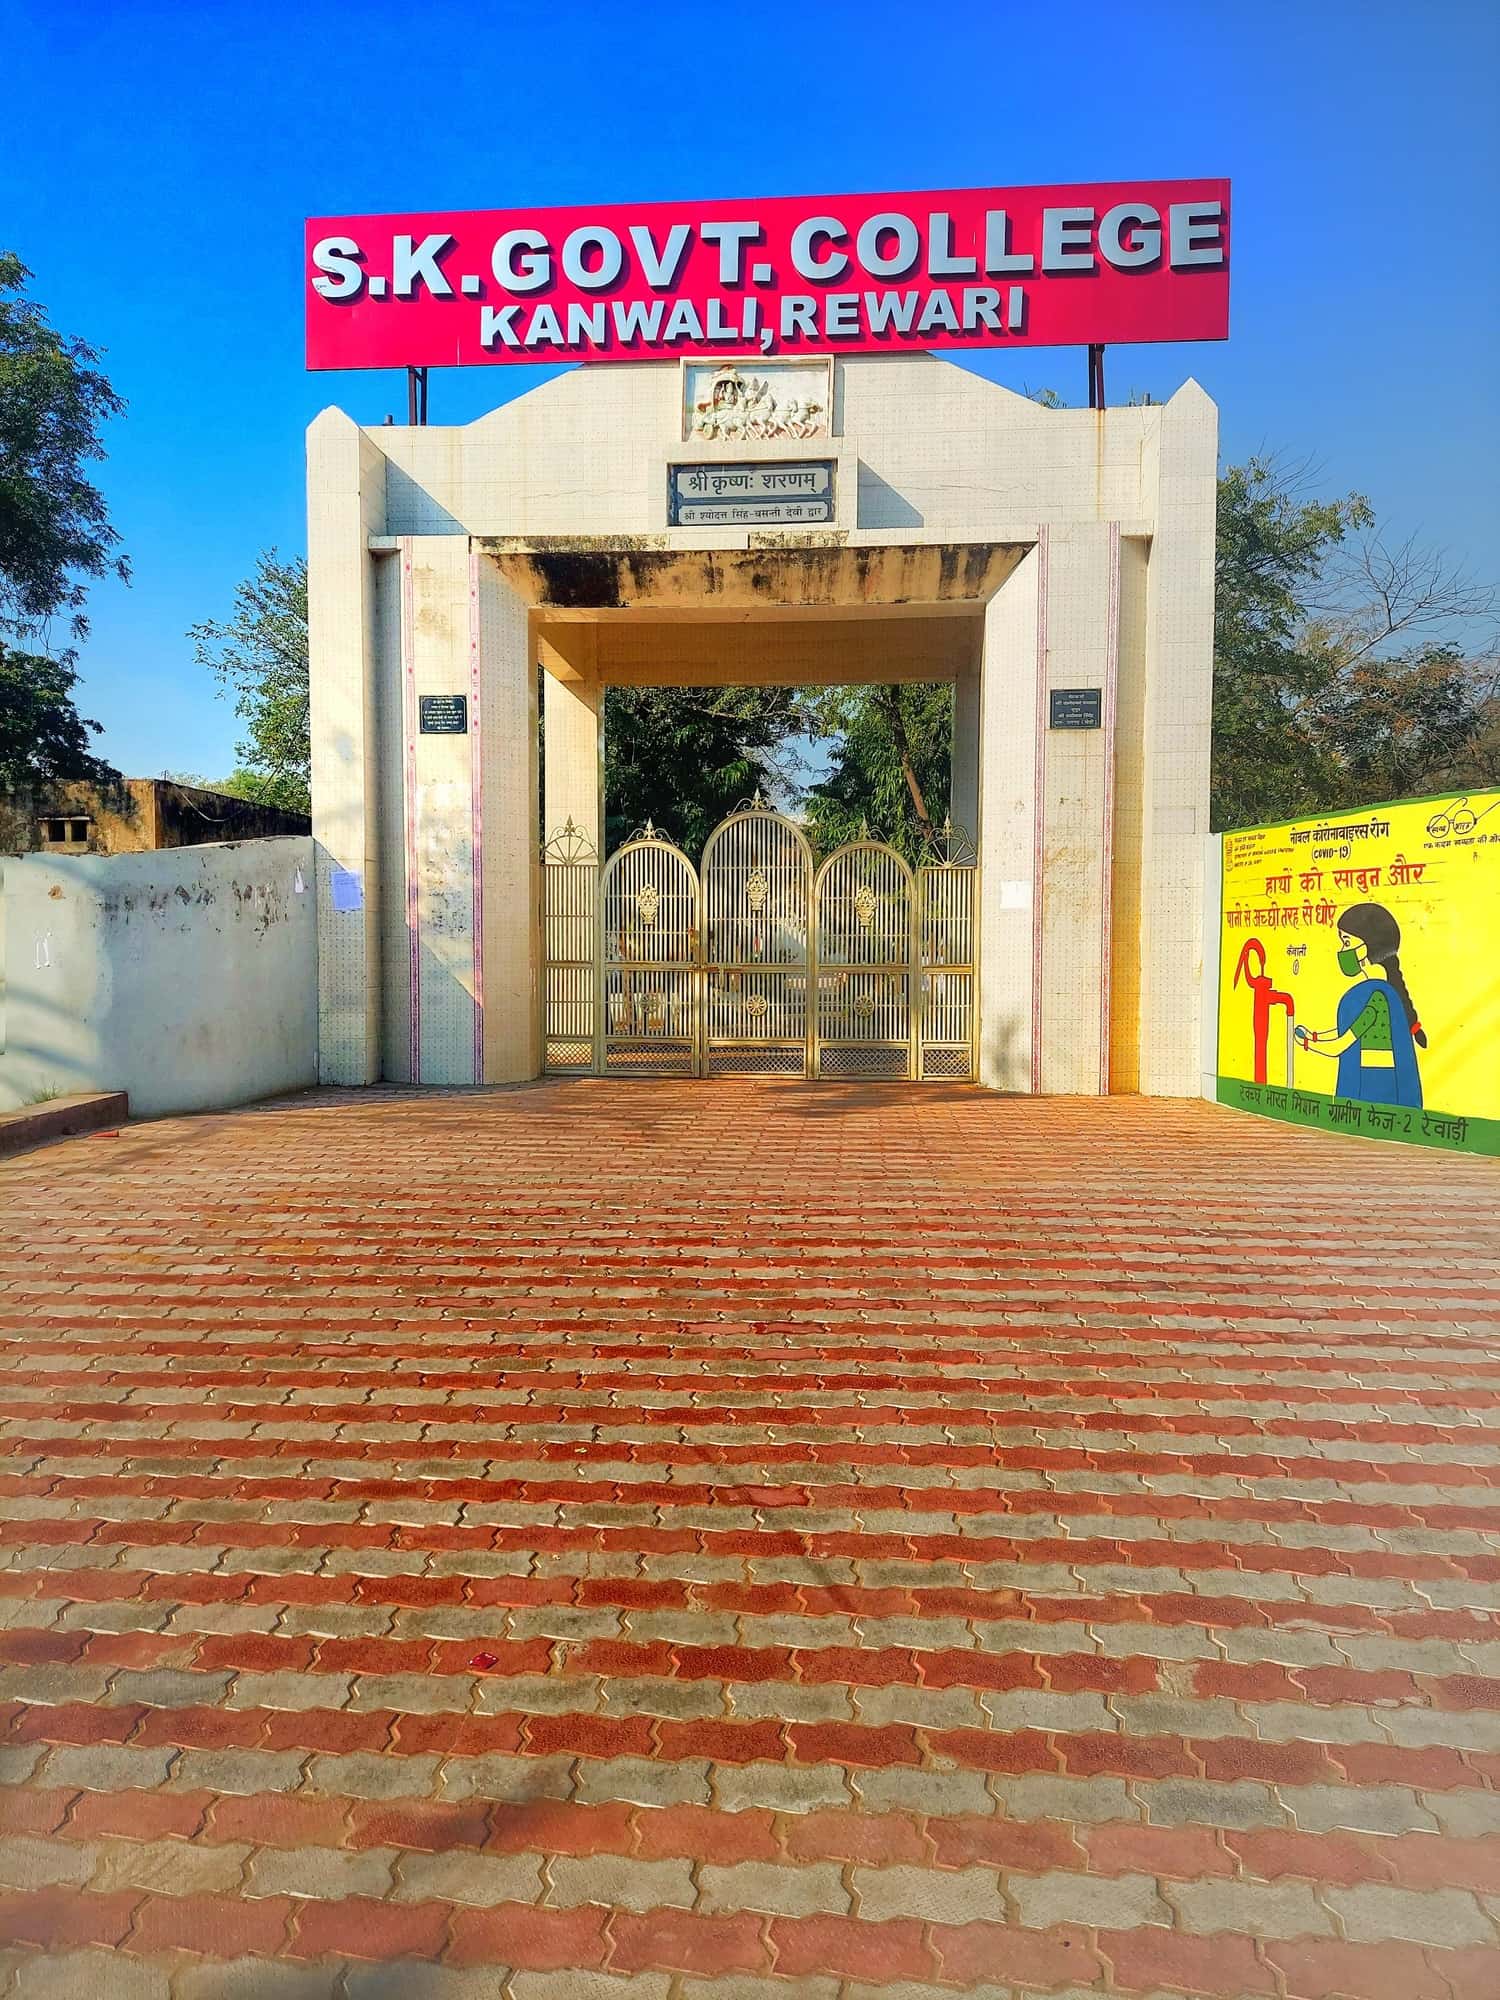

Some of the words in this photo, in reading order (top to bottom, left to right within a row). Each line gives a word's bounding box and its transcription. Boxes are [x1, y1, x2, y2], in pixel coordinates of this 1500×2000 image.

[791, 201, 1224, 280] COLLEGE
[689, 470, 707, 491] श्री
[761, 473, 816, 493] शरणम्
[1290, 827, 1311, 844] नोवल
[1370, 817, 1390, 838] रोग
[1299, 867, 1323, 891] को
[1333, 868, 1381, 893] साबुन
[1388, 854, 1426, 886] और
[1226, 902, 1242, 928] पानी
[1244, 903, 1252, 928] से
[1253, 901, 1280, 930] अच्छी
[1281, 907, 1299, 930] तरह
[1302, 899, 1314, 926] से
[1265, 1089, 1288, 1112] भारत
